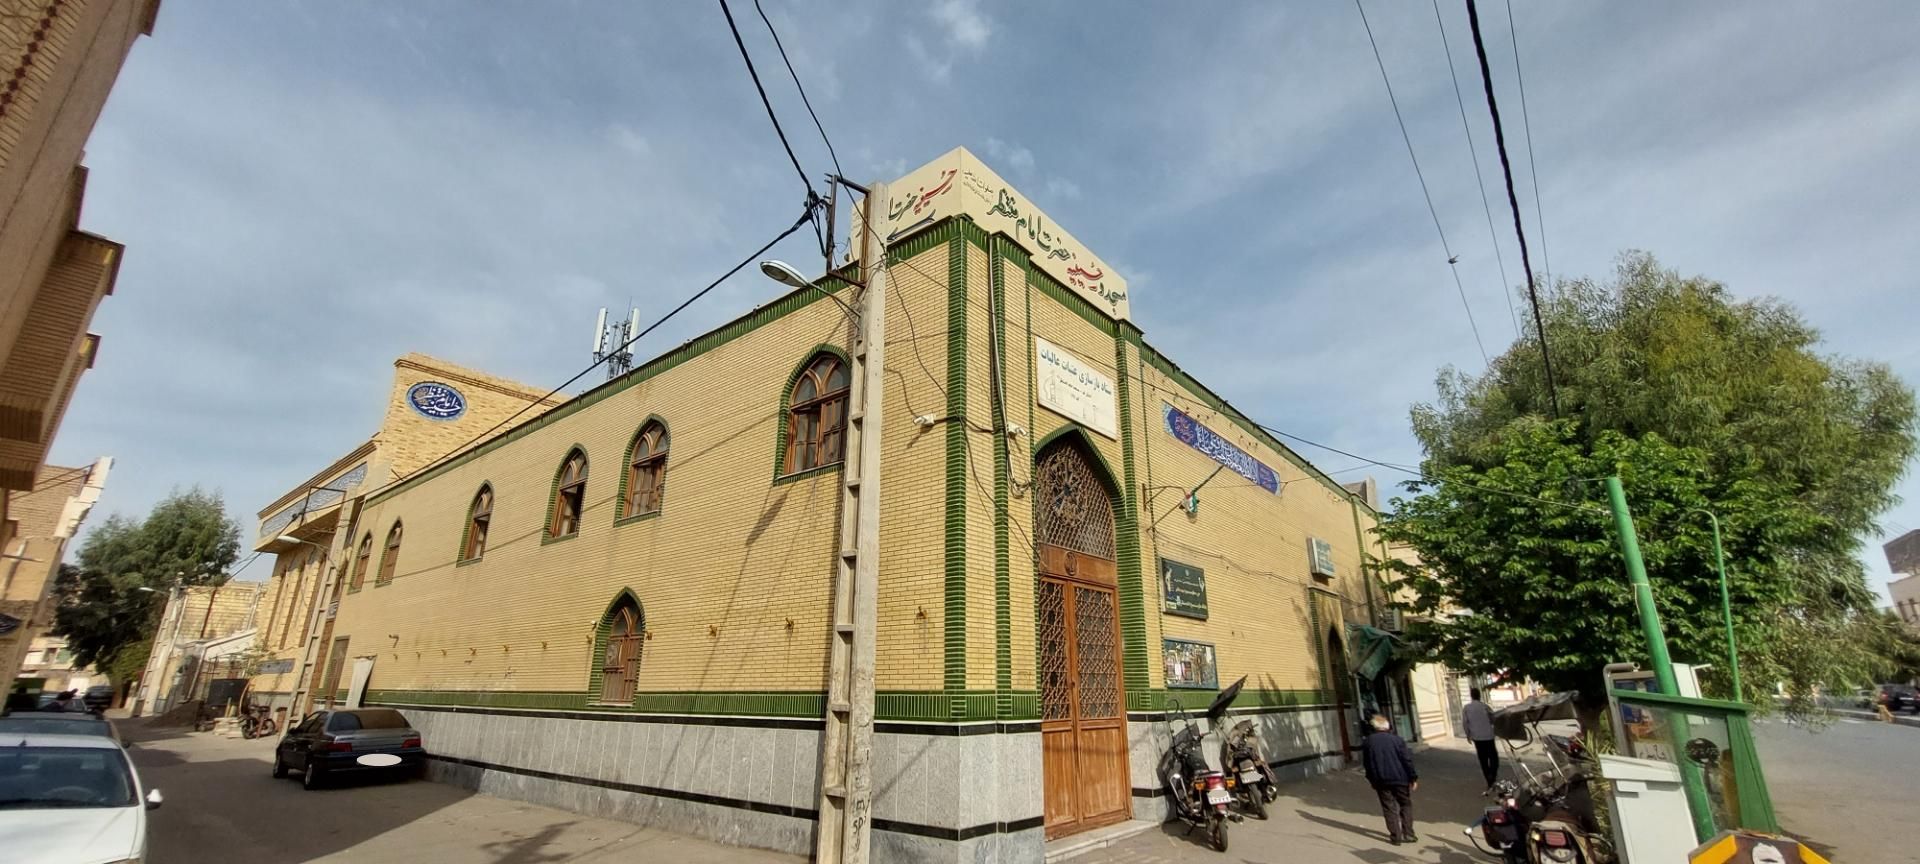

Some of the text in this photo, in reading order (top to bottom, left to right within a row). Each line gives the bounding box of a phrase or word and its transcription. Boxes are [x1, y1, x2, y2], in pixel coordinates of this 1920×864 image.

[986, 187, 1019, 219] منتظر
[1066, 253, 1104, 292] حسینیه
[1102, 290, 1128, 316] مسجد
[1040, 348, 1060, 366] عالیات
[1061, 360, 1077, 375] عتبات
[414, 386, 448, 400] منتظر
[1101, 381, 1112, 395] ستاد
[419, 401, 461, 416] حسینیه
